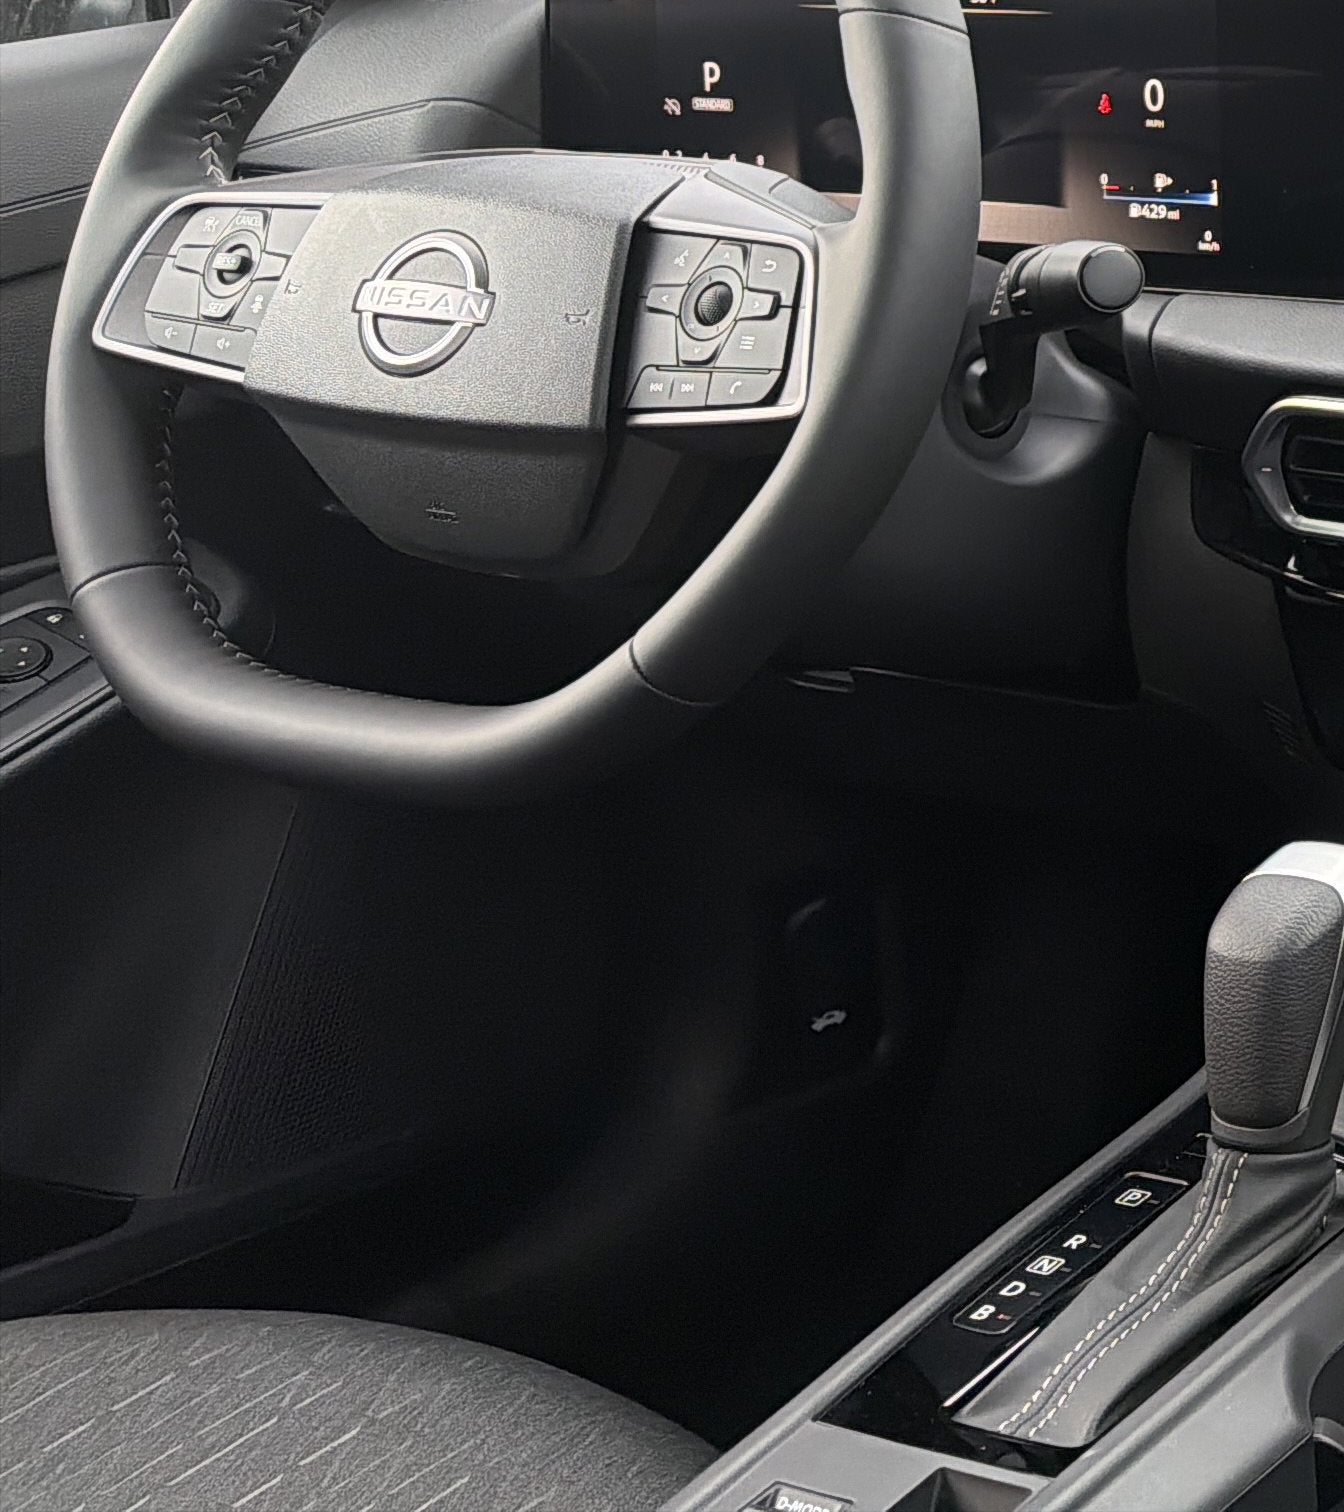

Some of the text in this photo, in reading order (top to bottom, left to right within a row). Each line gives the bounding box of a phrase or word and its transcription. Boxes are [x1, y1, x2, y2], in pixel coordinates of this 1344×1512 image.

[702, 60, 720, 92] P
[1143, 78, 1164, 112] 0
[1141, 202, 1180, 220] 429 mi
[207, 301, 226, 314] SET
[362, 285, 491, 320] NISSAN
[1063, 1233, 1087, 1249] R
[998, 1280, 1026, 1296] D
[970, 1303, 996, 1320] B
[774, 1495, 832, 1512] D-MO
